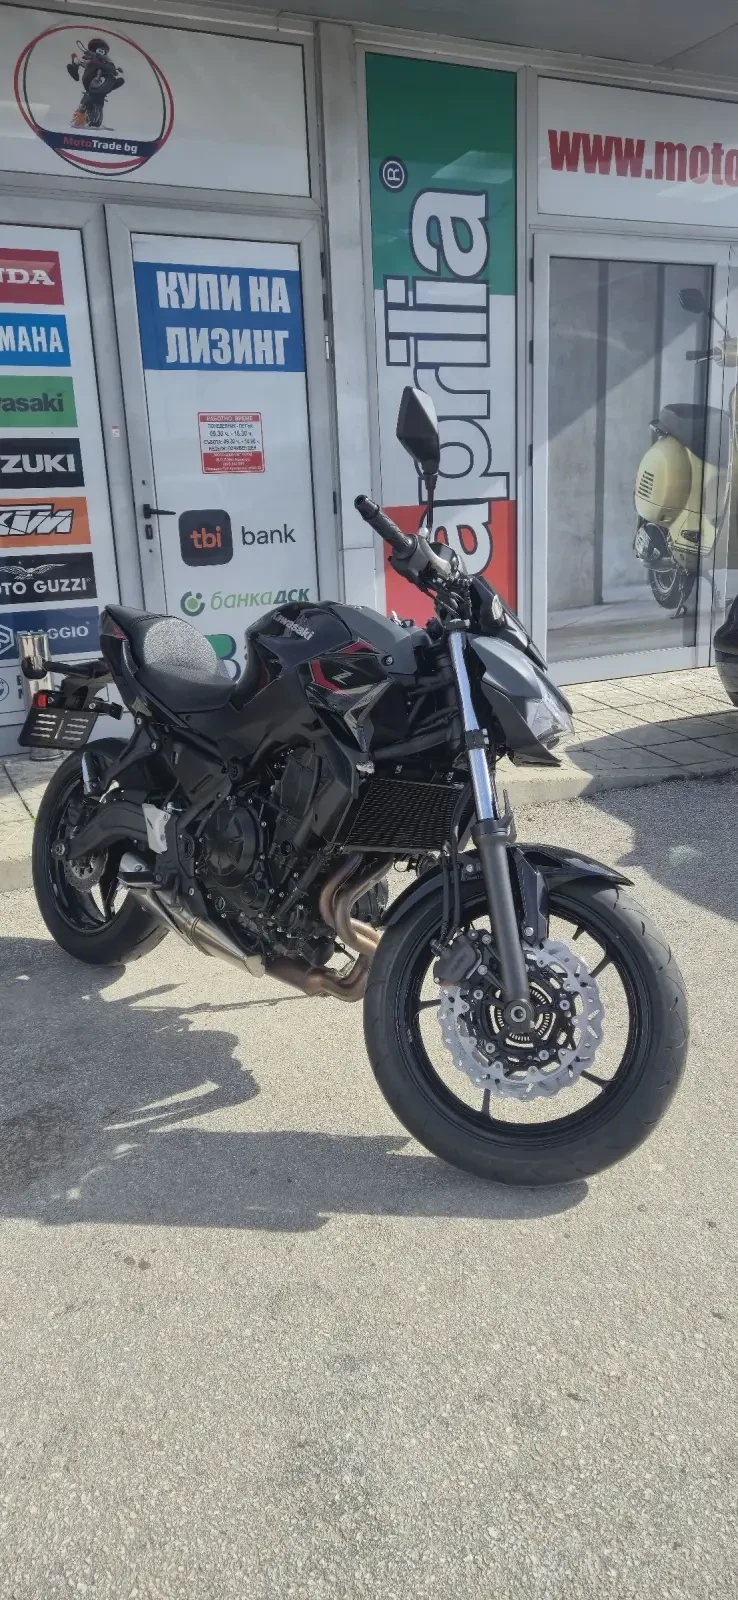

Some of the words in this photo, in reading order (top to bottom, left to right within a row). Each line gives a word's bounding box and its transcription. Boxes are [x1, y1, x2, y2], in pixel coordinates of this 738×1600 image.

[124, 143, 138, 154] bg
[548, 129, 738, 187] www.moto
[156, 270, 242, 312] КУПИ
[248, 275, 291, 313] НА
[165, 326, 289, 365] ЛИЗИНГ
[383, 187, 510, 576] aprilia
[0, 393, 64, 412] asaki
[0, 454, 76, 473] ZUKI
[190, 525, 223, 549] tbi
[241, 523, 296, 546] bank
[0, 581, 27, 596] TO
